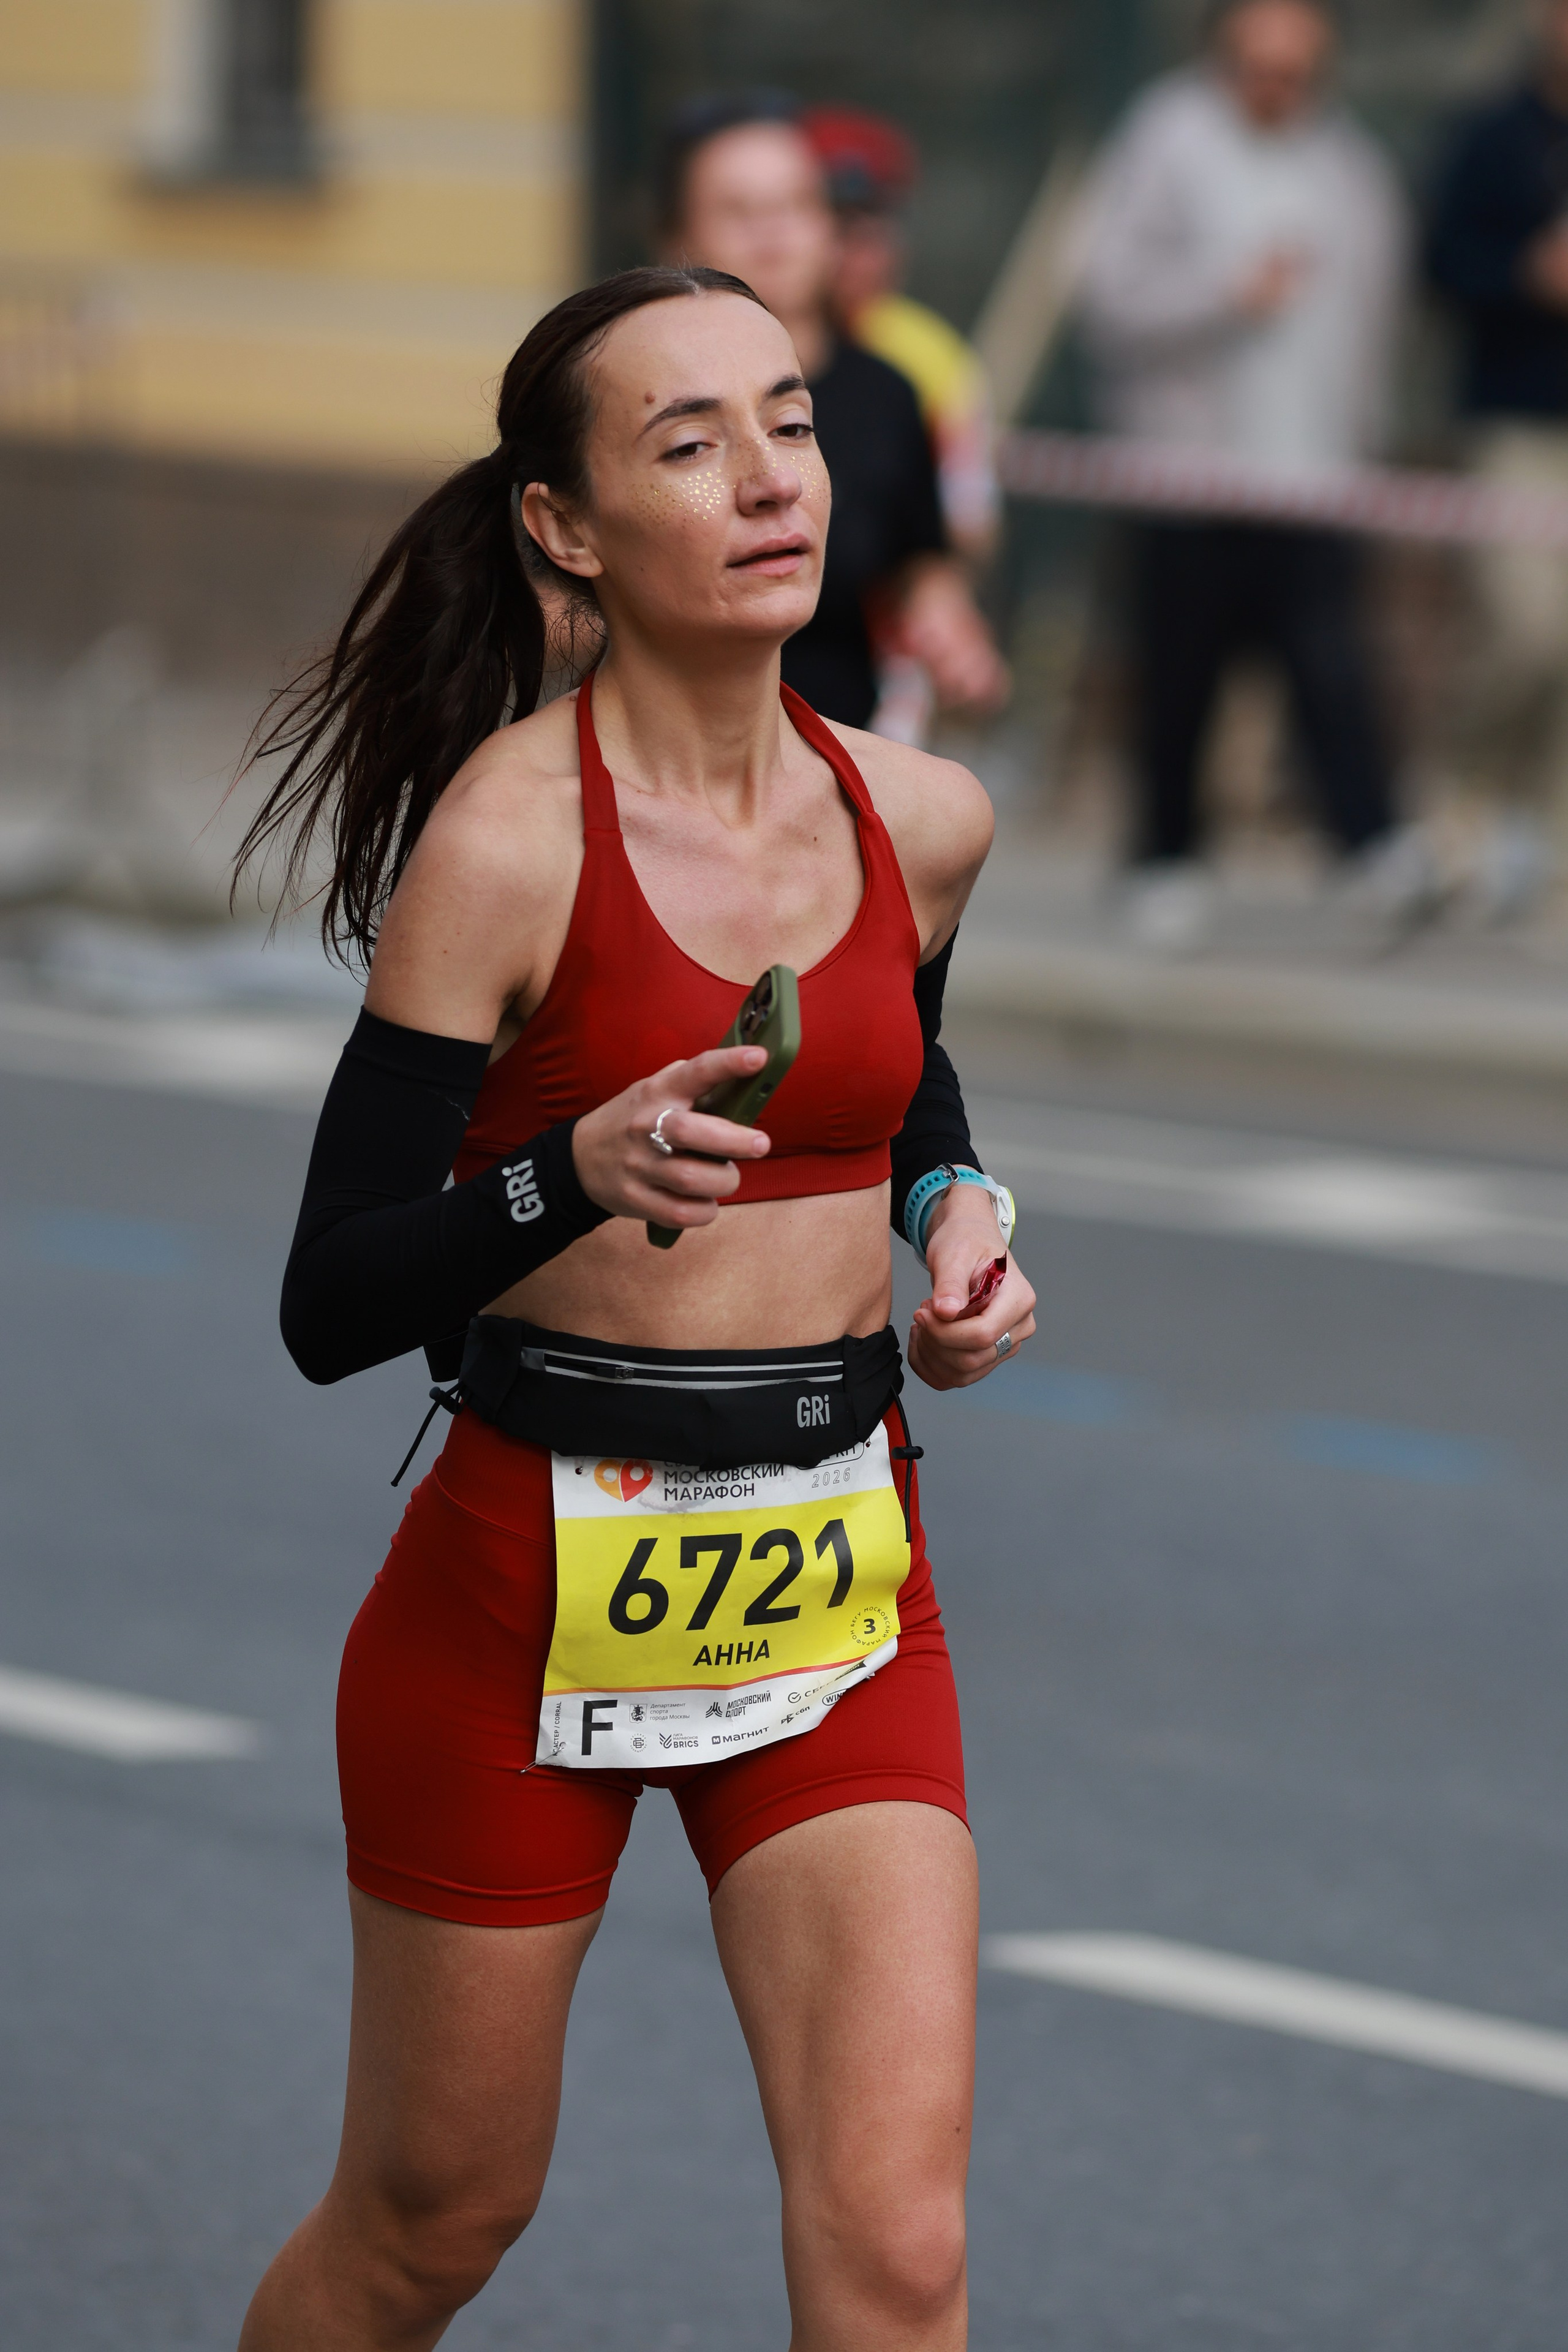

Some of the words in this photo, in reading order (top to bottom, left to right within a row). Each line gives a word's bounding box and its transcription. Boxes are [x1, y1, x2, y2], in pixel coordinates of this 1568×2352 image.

[502, 1158, 545, 1223] GRi
[797, 1394, 831, 1428] GRi
[812, 1468, 851, 1488] 2026
[664, 1483, 755, 1501] МАРАФОН
[608, 1518, 854, 1635] 6721
[864, 1618, 876, 1634] 3
[850, 1630, 881, 1646] МАРАФОН
[693, 1640, 771, 1667] АННА
[727, 1691, 771, 1709] МОСКОВСКИЙ
[725, 1706, 746, 1717] СПОРТ
[581, 1700, 617, 1755] F
